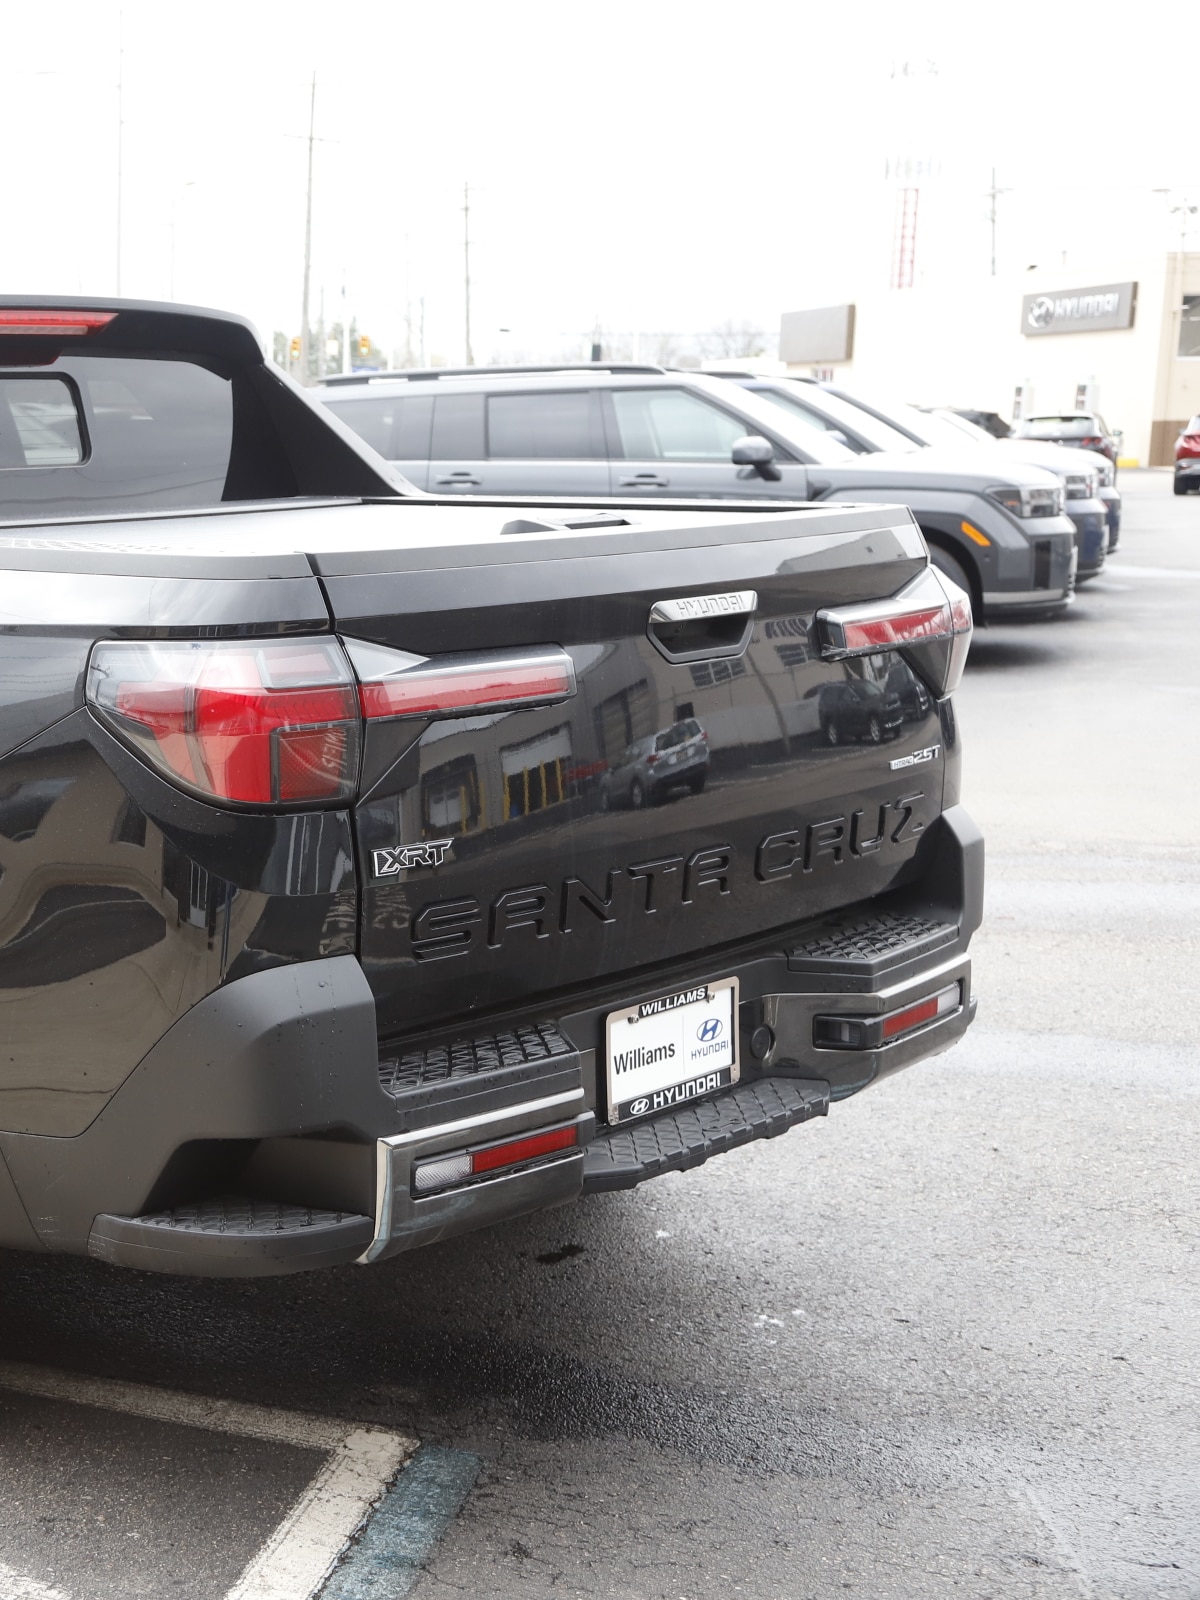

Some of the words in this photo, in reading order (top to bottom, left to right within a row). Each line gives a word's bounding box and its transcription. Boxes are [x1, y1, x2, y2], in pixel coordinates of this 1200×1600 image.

[1055, 292, 1119, 318] HYUNDAI
[676, 594, 746, 617] HYUNDAI
[373, 837, 455, 876] XRT
[411, 843, 737, 963] SANTA
[754, 793, 926, 884] CRUZ
[641, 987, 706, 1017] WILLIAMS
[613, 1042, 676, 1075] Williams
[691, 1039, 729, 1061] HYUNDAI
[653, 1072, 721, 1109] HYUNDAI
